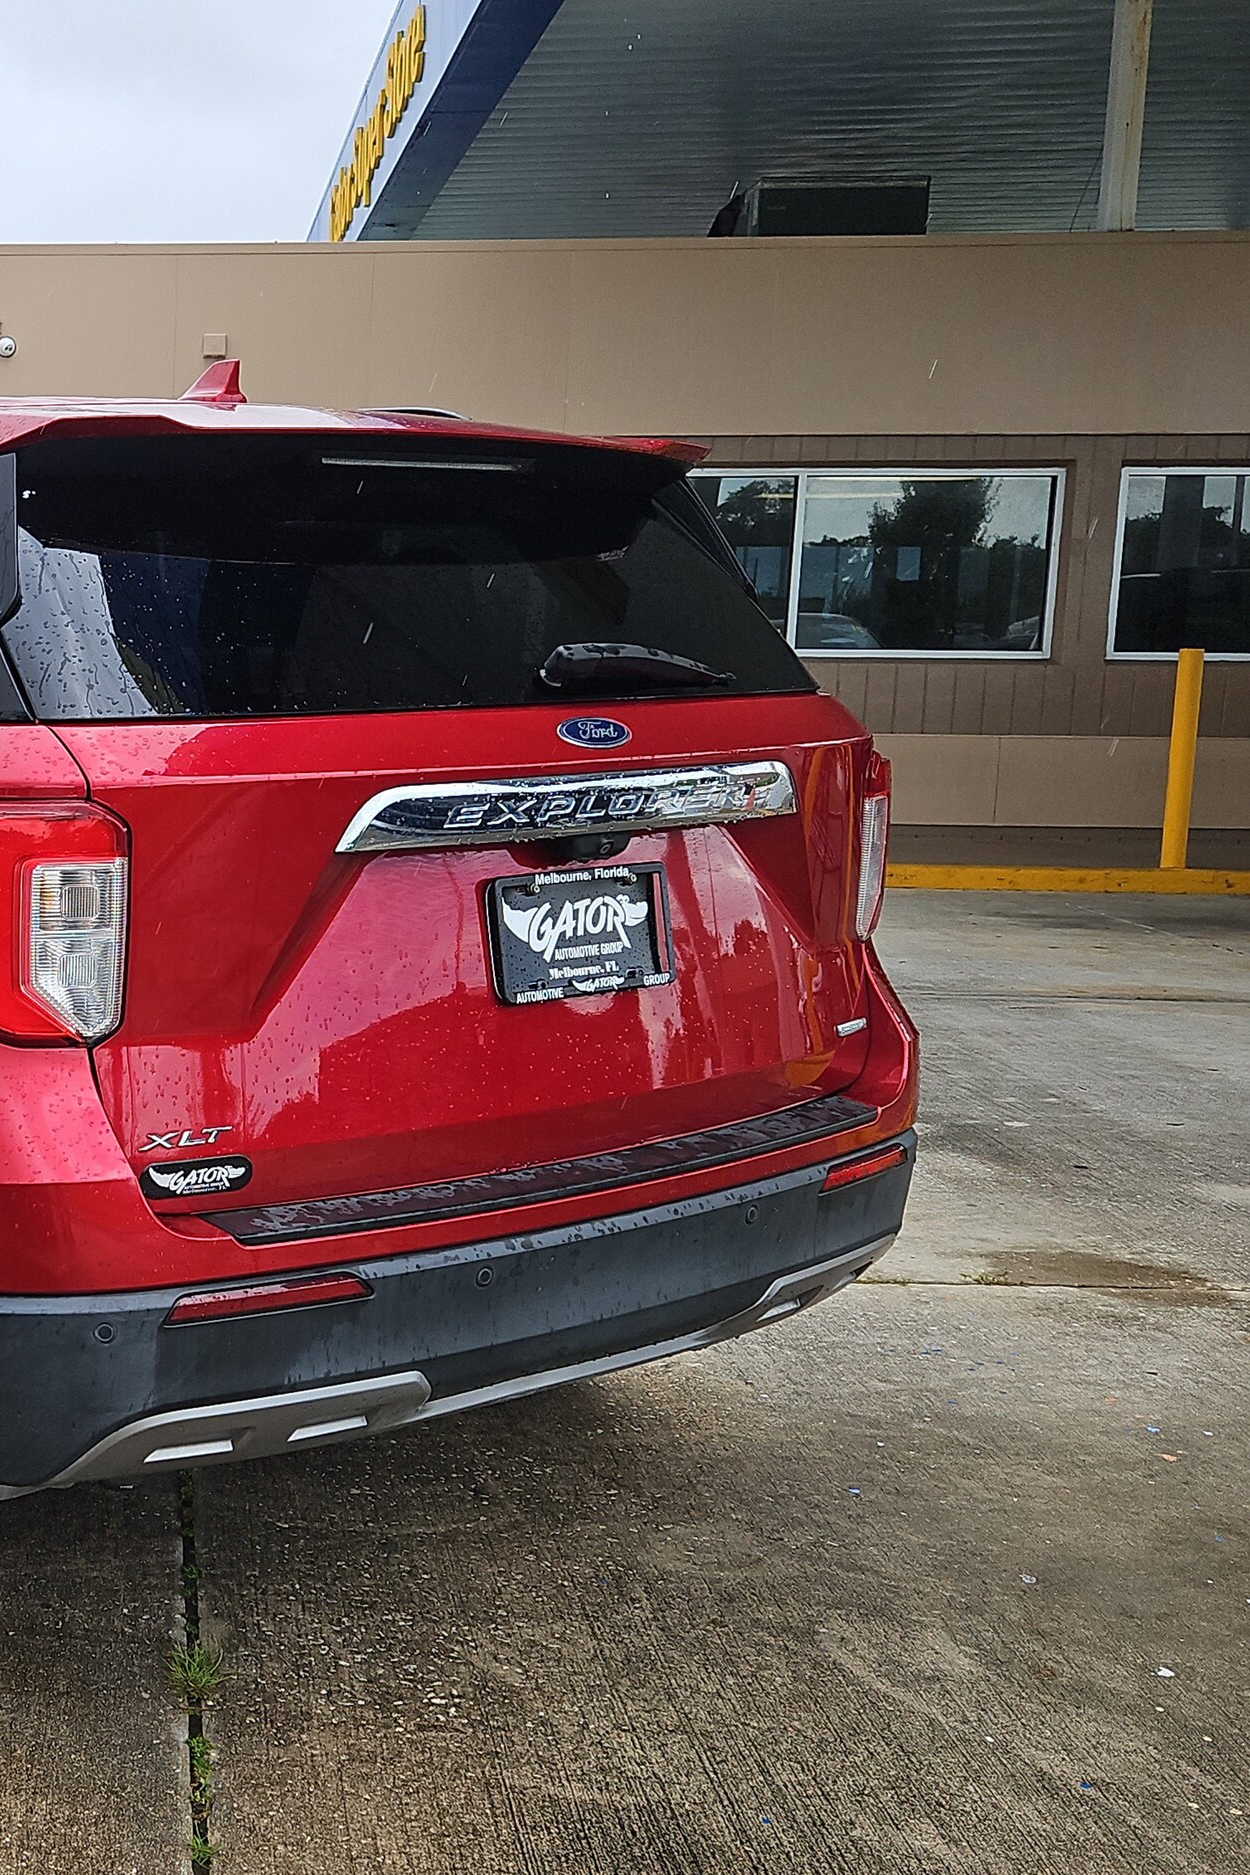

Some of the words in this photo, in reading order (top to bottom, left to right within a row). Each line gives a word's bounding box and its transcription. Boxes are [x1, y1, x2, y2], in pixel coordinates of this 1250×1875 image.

[352, 87, 387, 208] Super
[384, 4, 425, 138] Store
[577, 721, 618, 740] Ford
[443, 783, 751, 829] EXPLORER
[535, 871, 592, 886] Melbourne,
[594, 866, 629, 879] Florida
[529, 896, 631, 963] GATOR
[554, 944, 600, 961] AUTOMOTIVE
[600, 941, 624, 955] GROUP
[516, 987, 564, 1004] AUTOMOTIVE
[586, 976, 618, 992] GATOR
[643, 973, 670, 986] GROUP
[138, 1125, 233, 1151] XLT
[168, 1166, 230, 1194] GATOR
